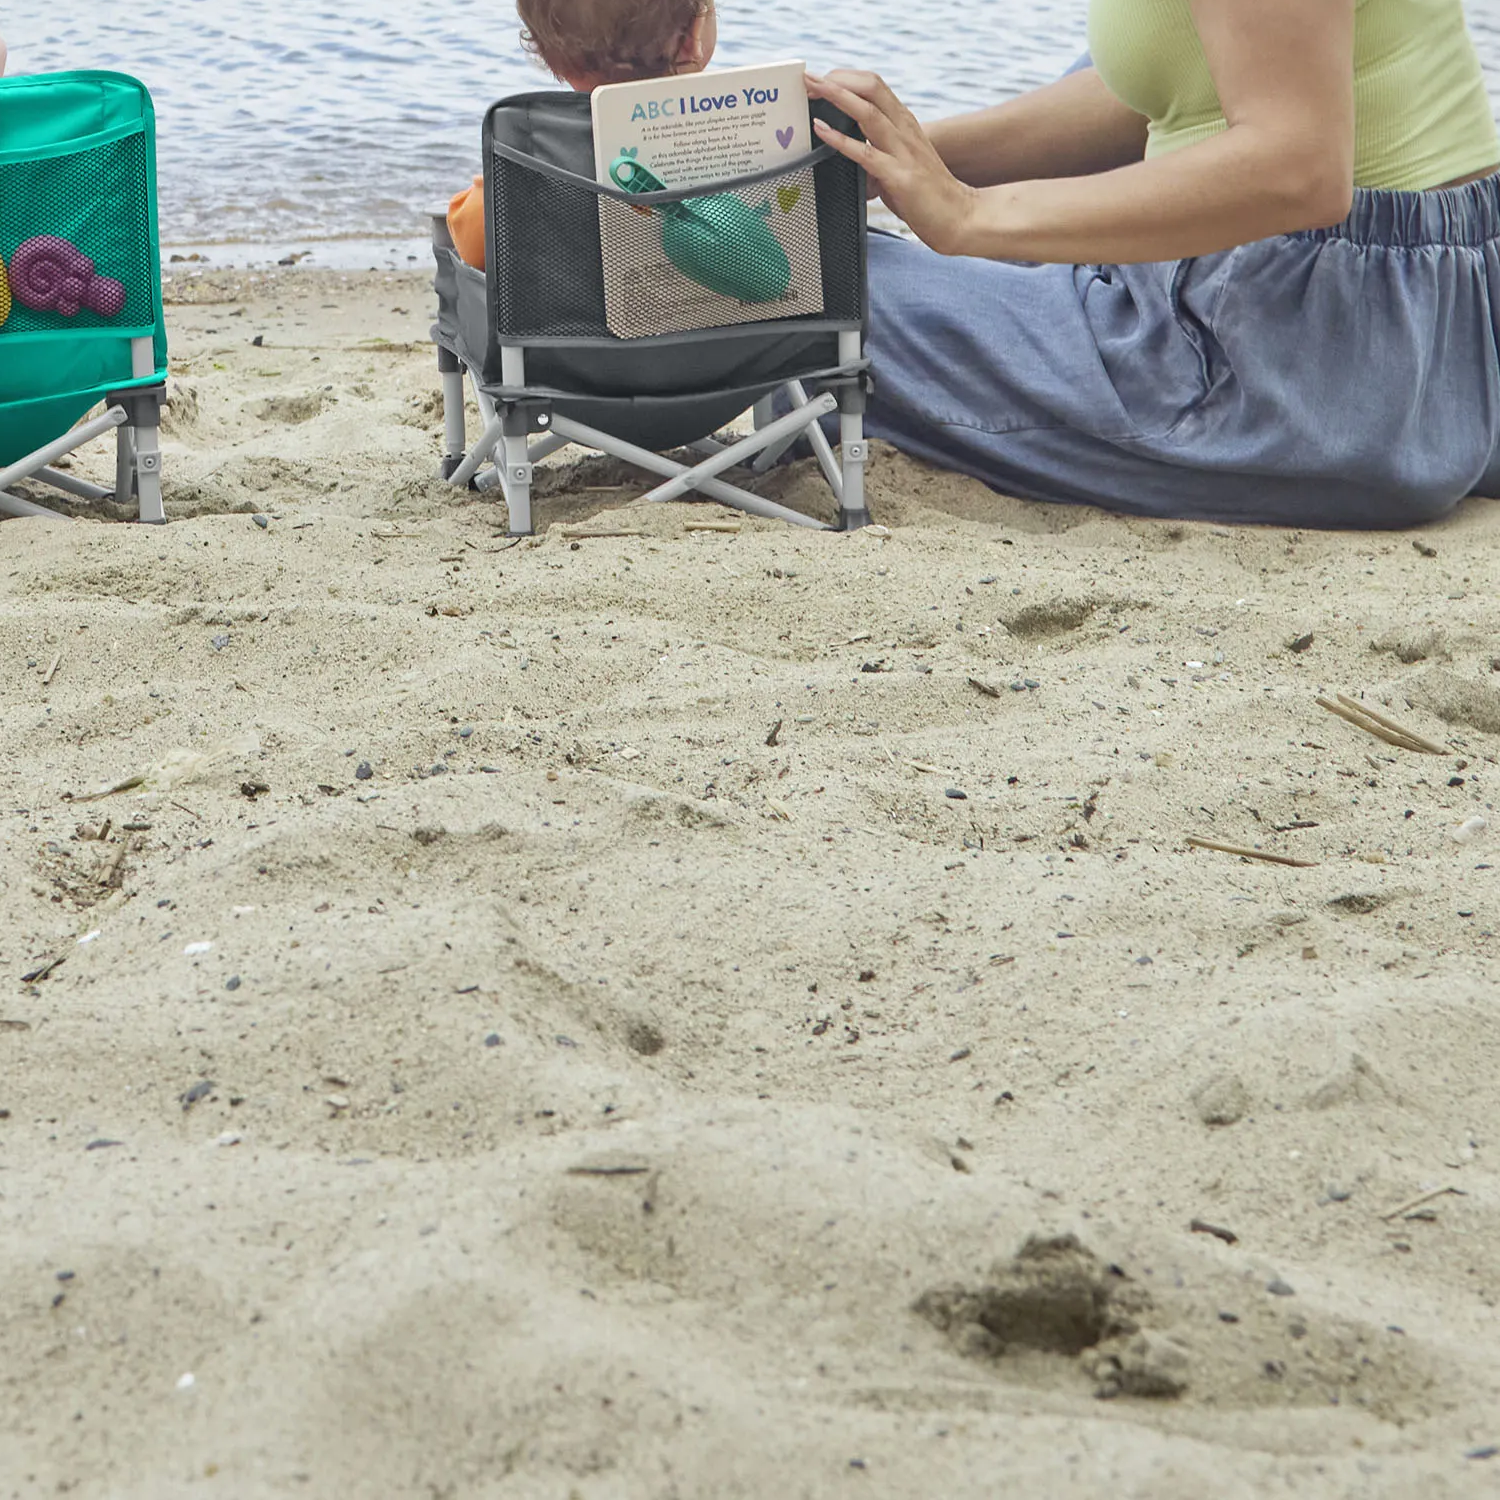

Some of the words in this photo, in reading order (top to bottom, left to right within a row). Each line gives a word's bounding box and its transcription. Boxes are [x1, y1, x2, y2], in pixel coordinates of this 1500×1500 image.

[631, 98, 675, 121] ABC
[679, 97, 686, 114] I
[690, 94, 737, 113] Love
[742, 88, 778, 106] You
